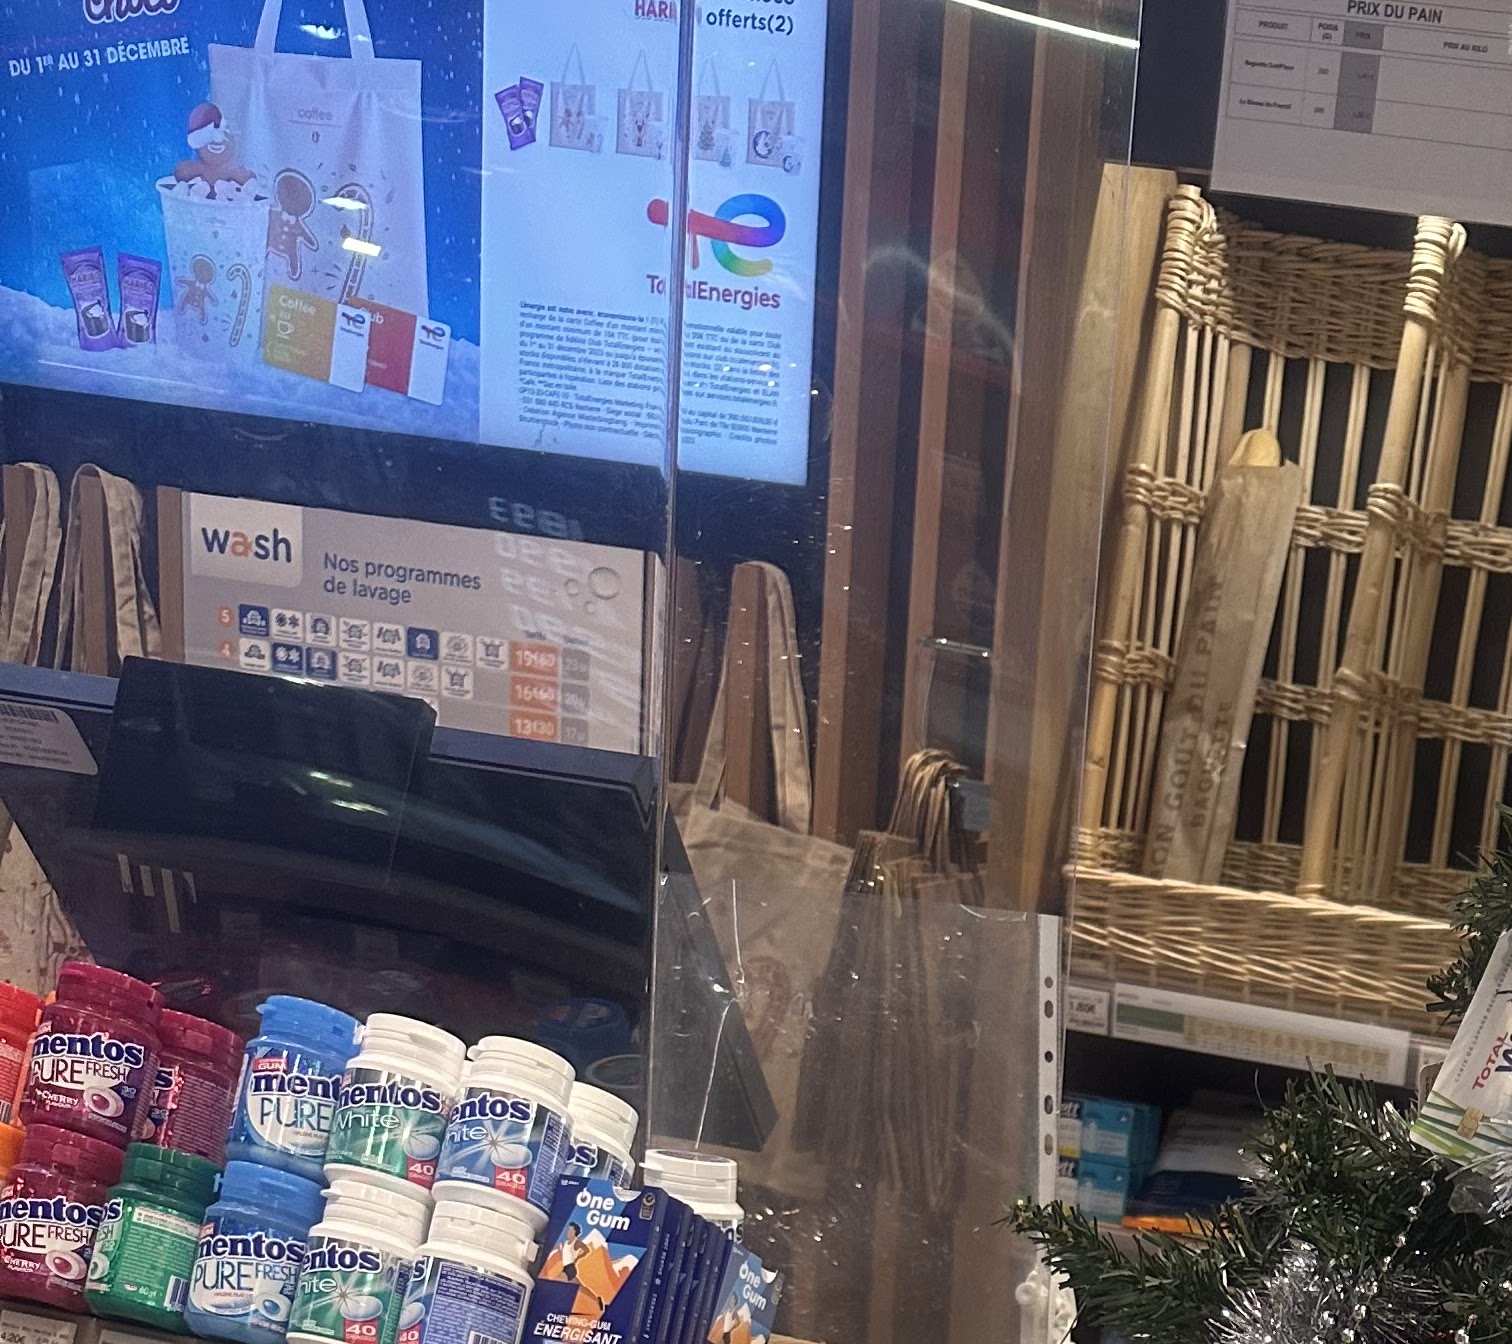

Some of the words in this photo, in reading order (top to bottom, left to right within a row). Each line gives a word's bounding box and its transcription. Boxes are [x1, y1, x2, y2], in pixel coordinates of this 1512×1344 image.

[706, 10, 794, 36] offerts(2)
[1347, 0, 1380, 17] PRIX
[1384, 4, 1403, 20] DU
[1408, 6, 1443, 24] PAIN
[9, 59, 32, 77] DU
[58, 52, 80, 71] AU
[84, 48, 101, 68] 31
[106, 36, 190, 64] DÉCEMBRE
[646, 273, 782, 311] TolEnergies
[202, 524, 293, 564] wash
[324, 552, 360, 575] Nos
[364, 559, 482, 591] programmes
[324, 576, 348, 596] de
[353, 582, 412, 605] lavage
[86, 1060, 128, 1083] FRESH
[1472, 1032, 1509, 1090] TOTAL
[260, 1097, 330, 1133] PURE
[408, 1162, 434, 1175] 40
[496, 1171, 526, 1186] 40
[576, 1187, 615, 1211] One
[586, 1210, 630, 1231] Gum
[47, 1225, 92, 1247] FRESH
[192, 1260, 254, 1291] PURE
[255, 1264, 298, 1282] FRESH
[739, 1260, 761, 1289] One
[742, 1284, 767, 1311] Gum
[345, 1324, 376, 1336] 40
[547, 1313, 612, 1332] CHEWING-GUM
